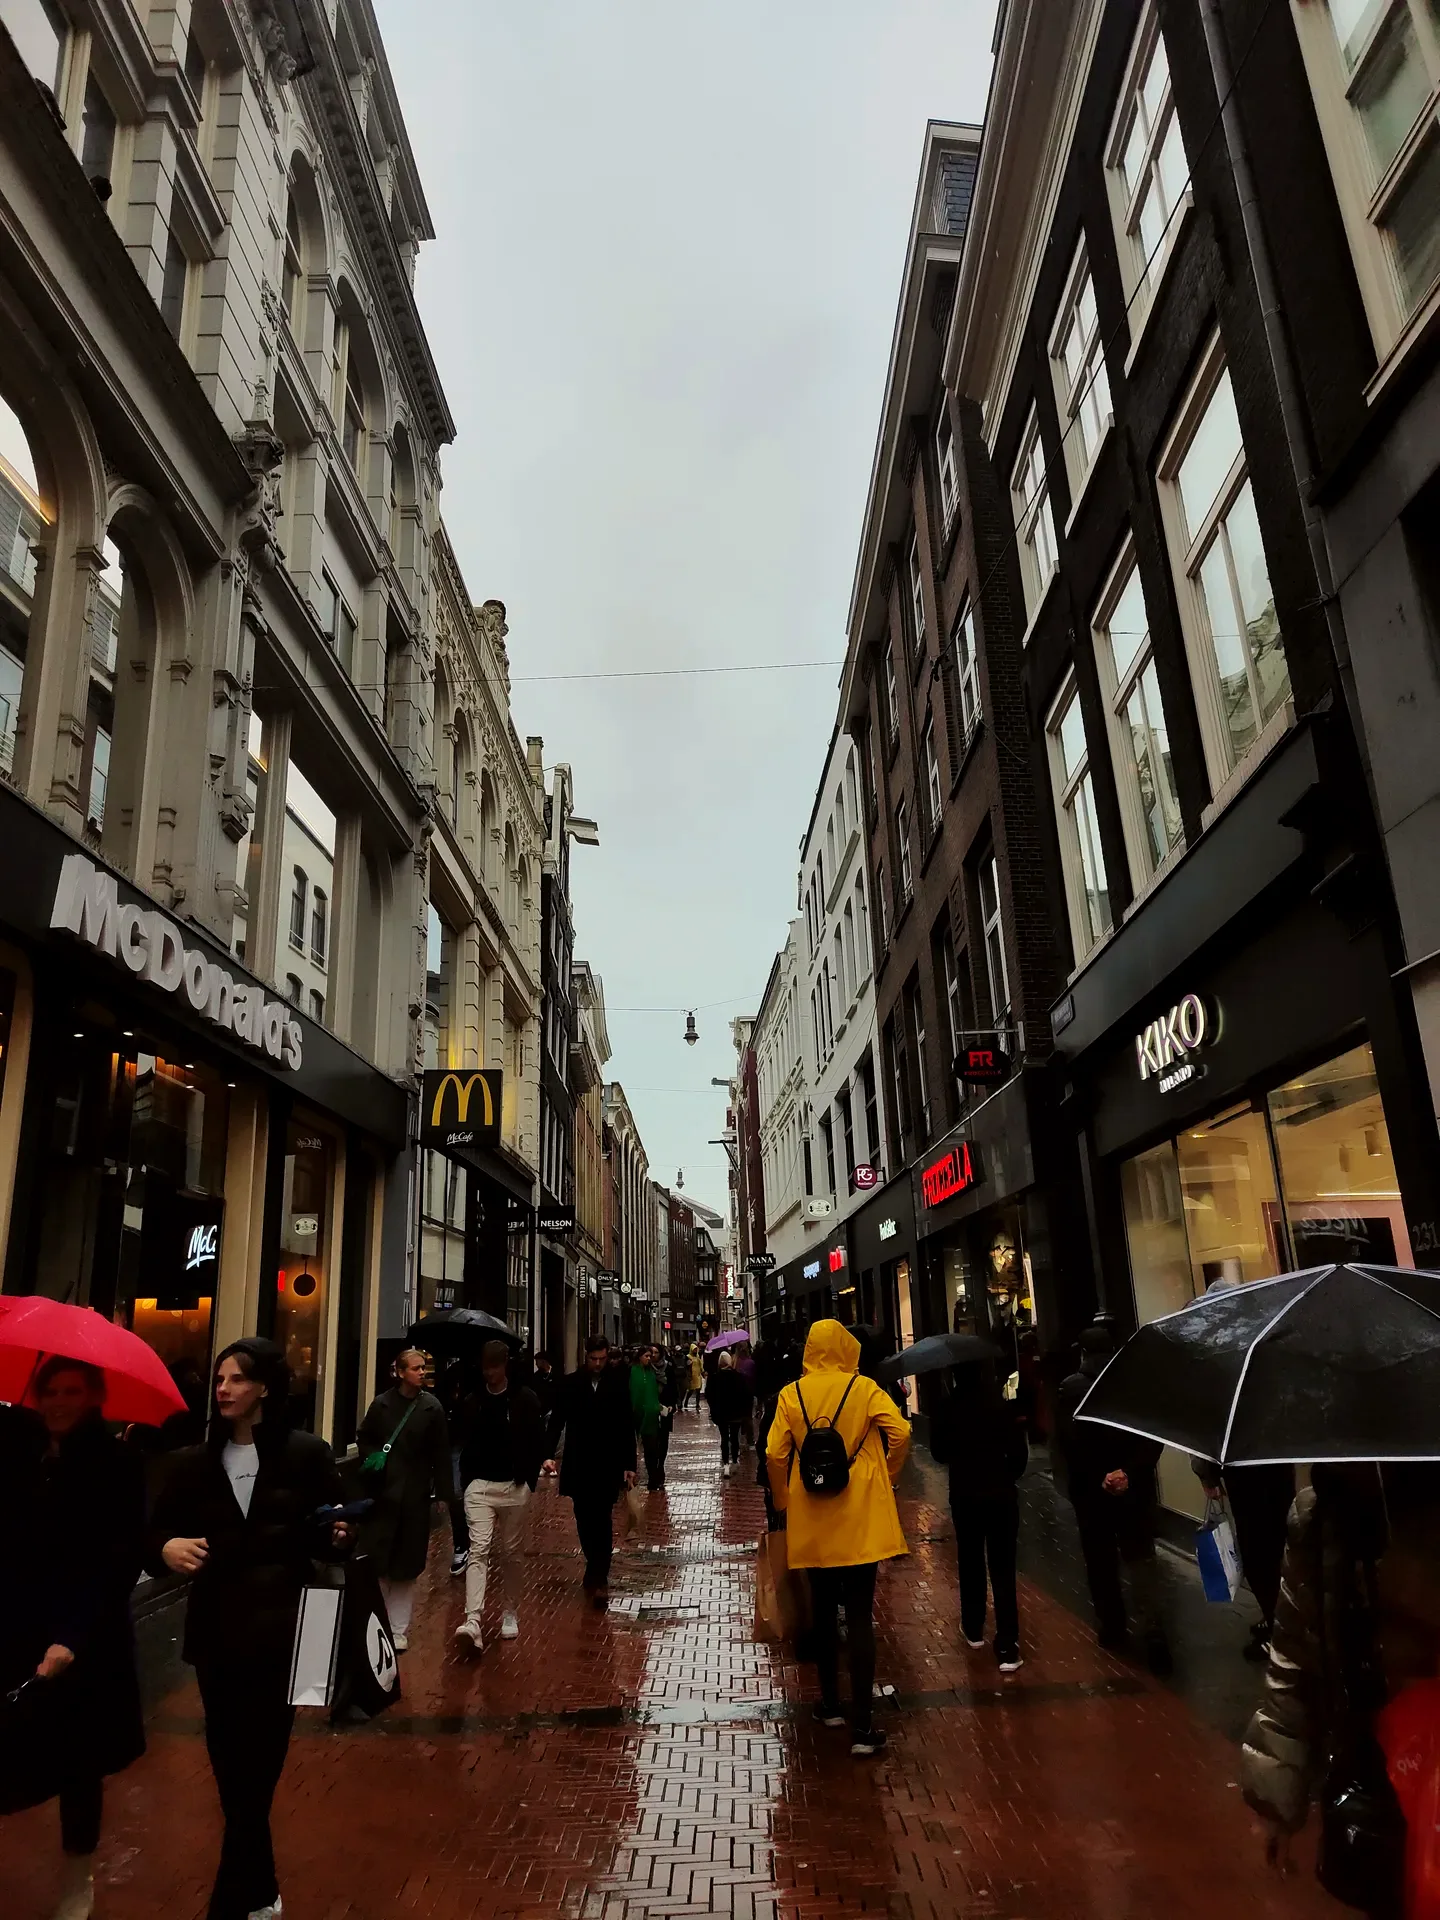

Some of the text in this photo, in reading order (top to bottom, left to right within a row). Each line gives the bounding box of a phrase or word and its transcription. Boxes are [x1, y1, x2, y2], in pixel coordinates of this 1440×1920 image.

[49, 854, 303, 1072] McDonald's
[1135, 993, 1208, 1081] KIKO
[1159, 1064, 1196, 1094] MILANO
[540, 1219, 572, 1228] NELSON
[749, 1256, 773, 1264] NANA
